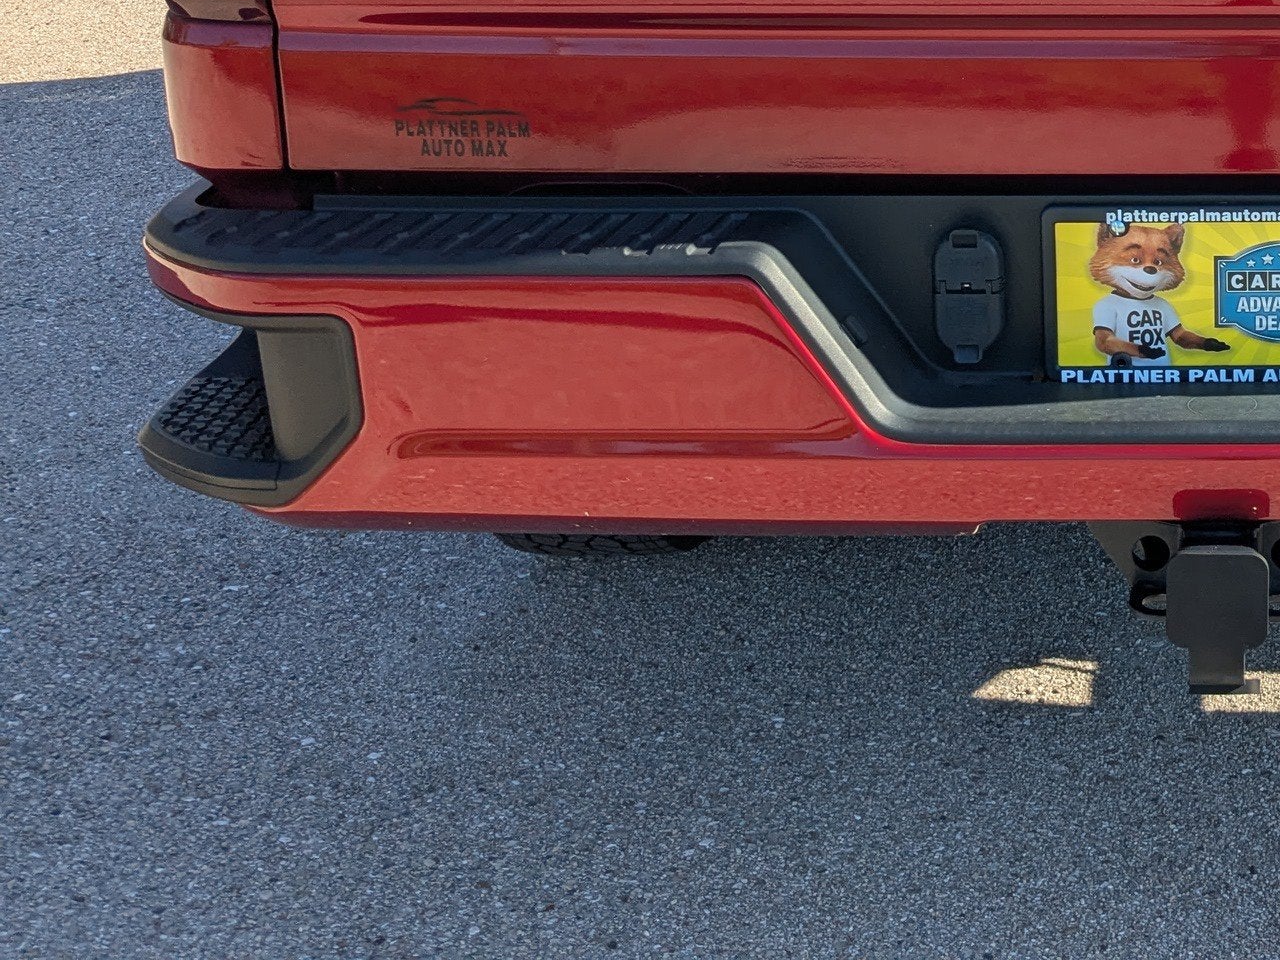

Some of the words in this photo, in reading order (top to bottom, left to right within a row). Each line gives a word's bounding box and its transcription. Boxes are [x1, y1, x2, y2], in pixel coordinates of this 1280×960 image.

[394, 120, 480, 138] PLATTNER
[485, 120, 531, 138] PALM
[420, 139, 466, 157] AUTO
[471, 140, 509, 158] MAX
[1126, 309, 1163, 329] CAR
[1128, 328, 1165, 347] FOX
[1060, 369, 1181, 384] PLATTNER
[1188, 368, 1255, 383] PALM
